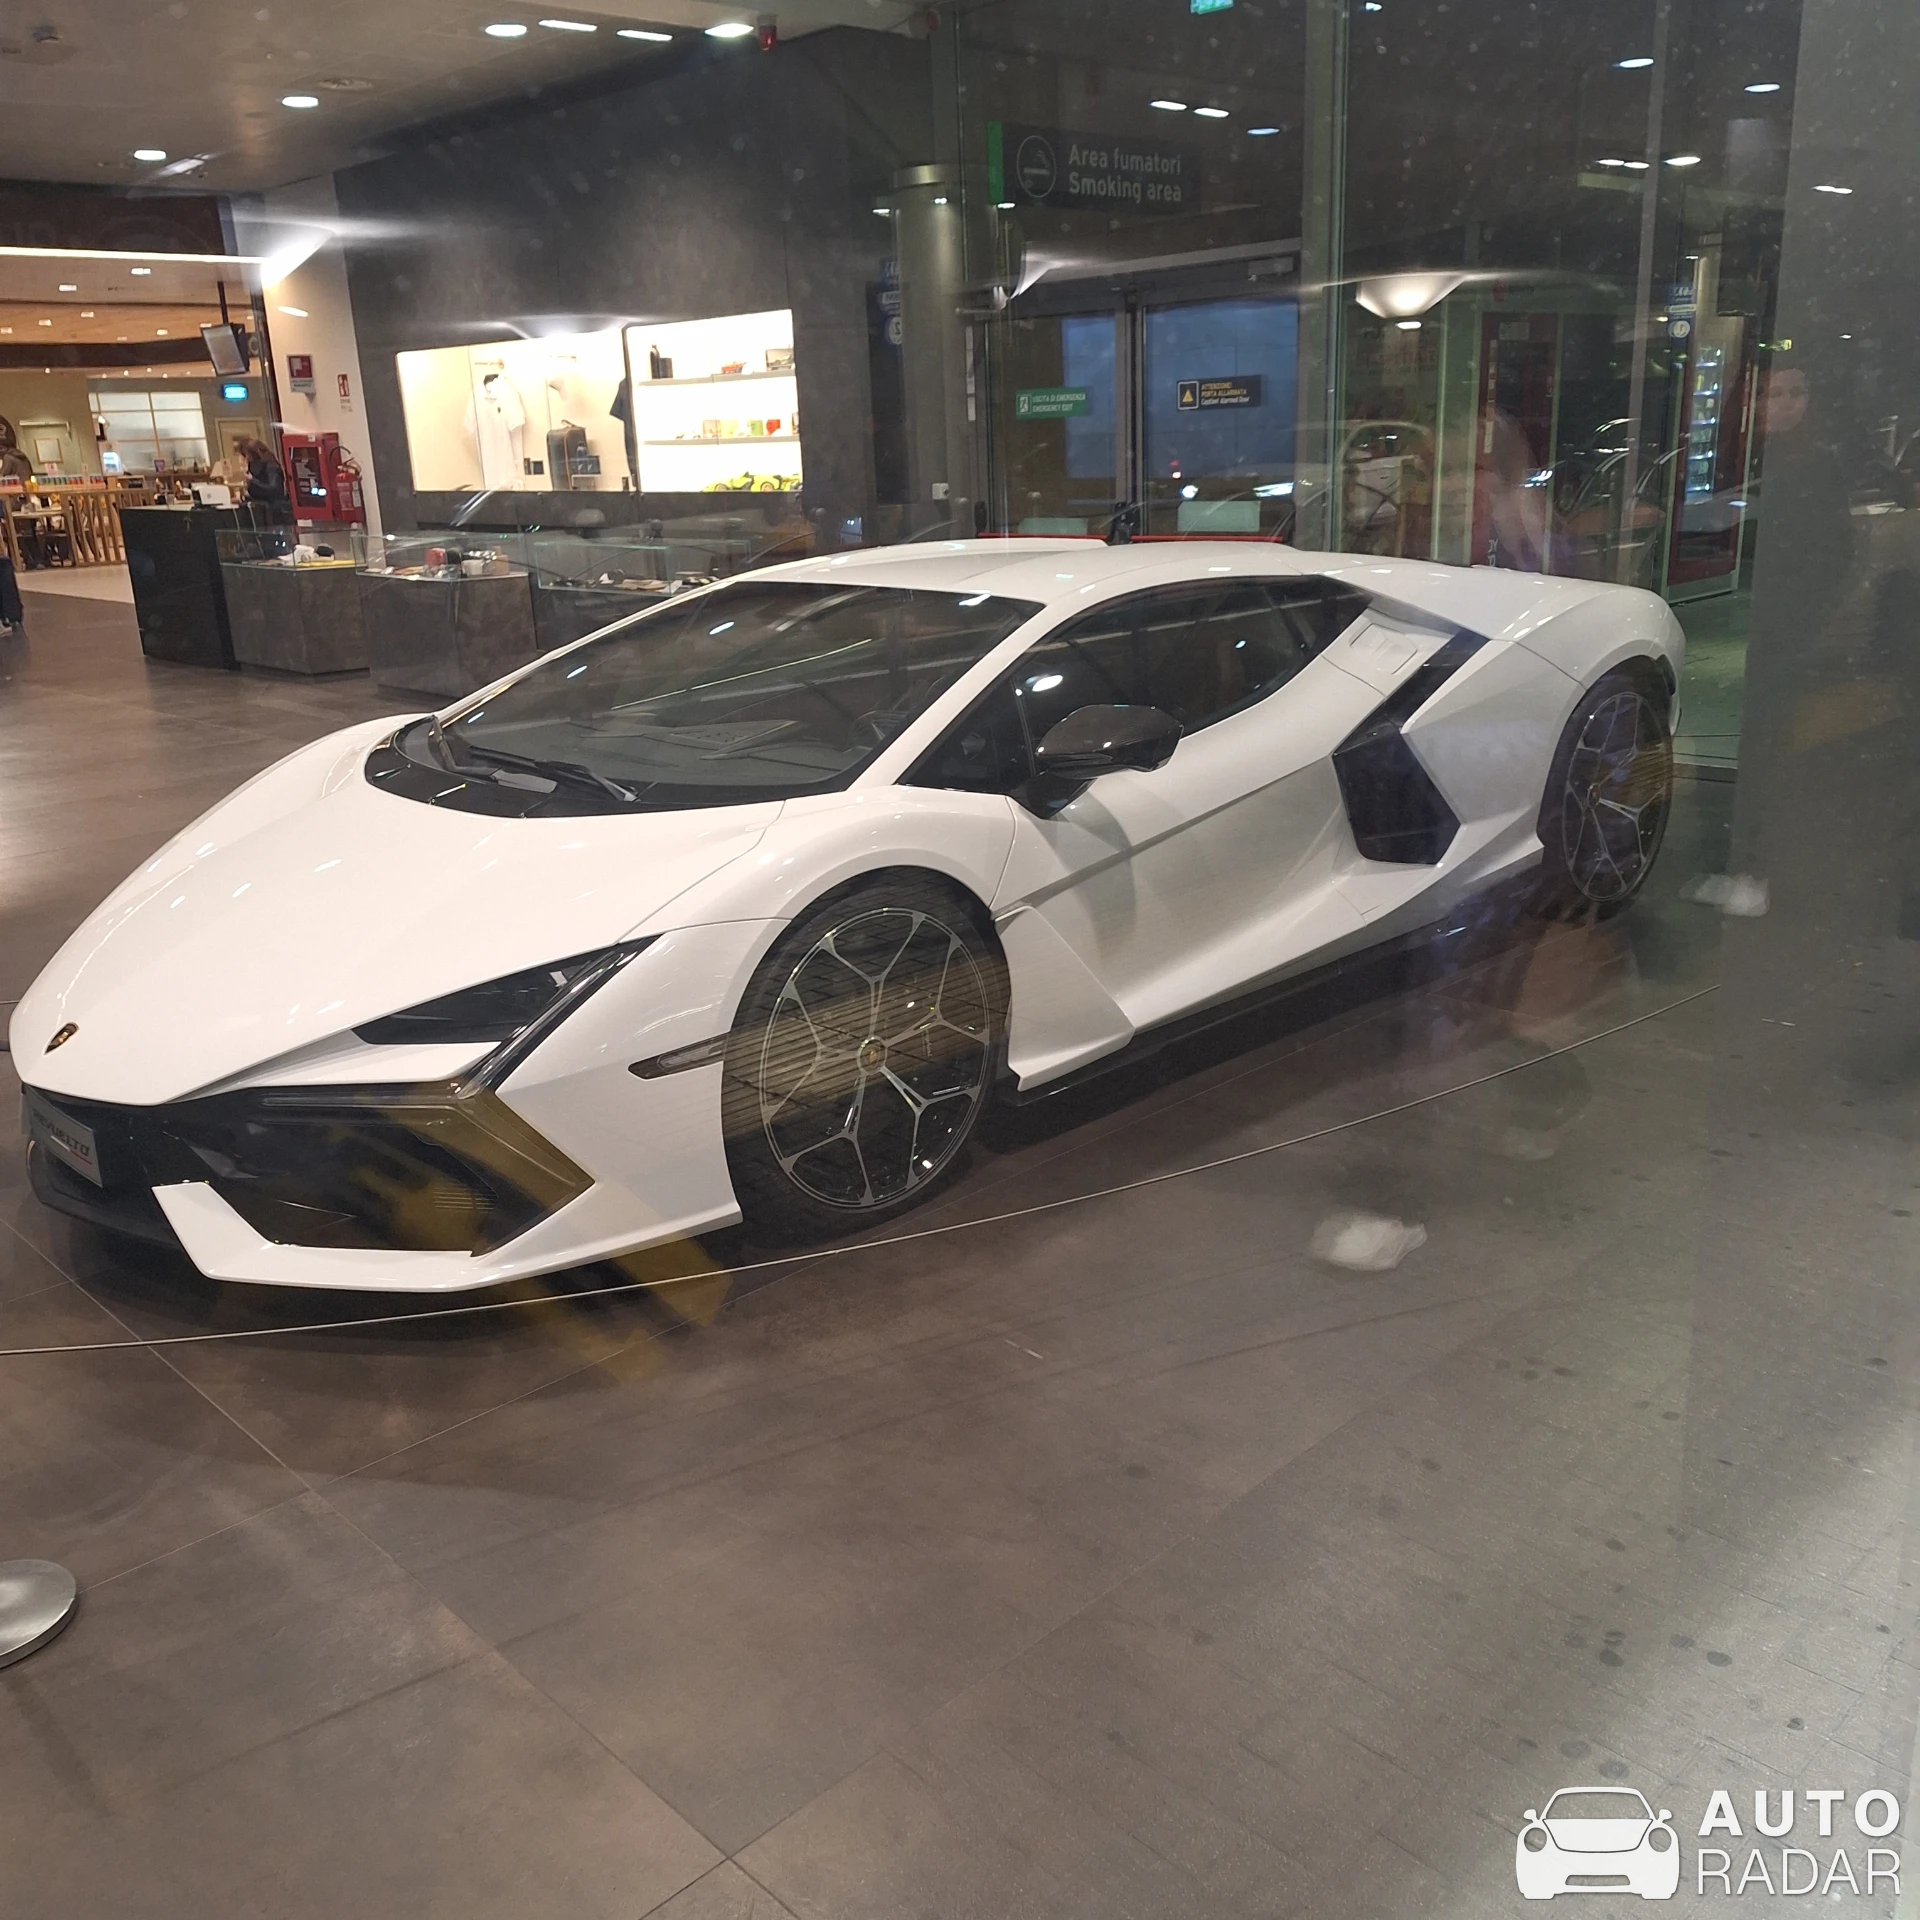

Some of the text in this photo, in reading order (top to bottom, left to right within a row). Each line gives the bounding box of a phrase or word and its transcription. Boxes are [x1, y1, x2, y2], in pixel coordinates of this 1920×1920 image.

[1068, 143, 1181, 175] Area fumatori
[1068, 171, 1182, 204] Smoking area
[1056, 392, 1086, 402] EMERGENZA
[1032, 404, 1061, 413] EMERGENCY
